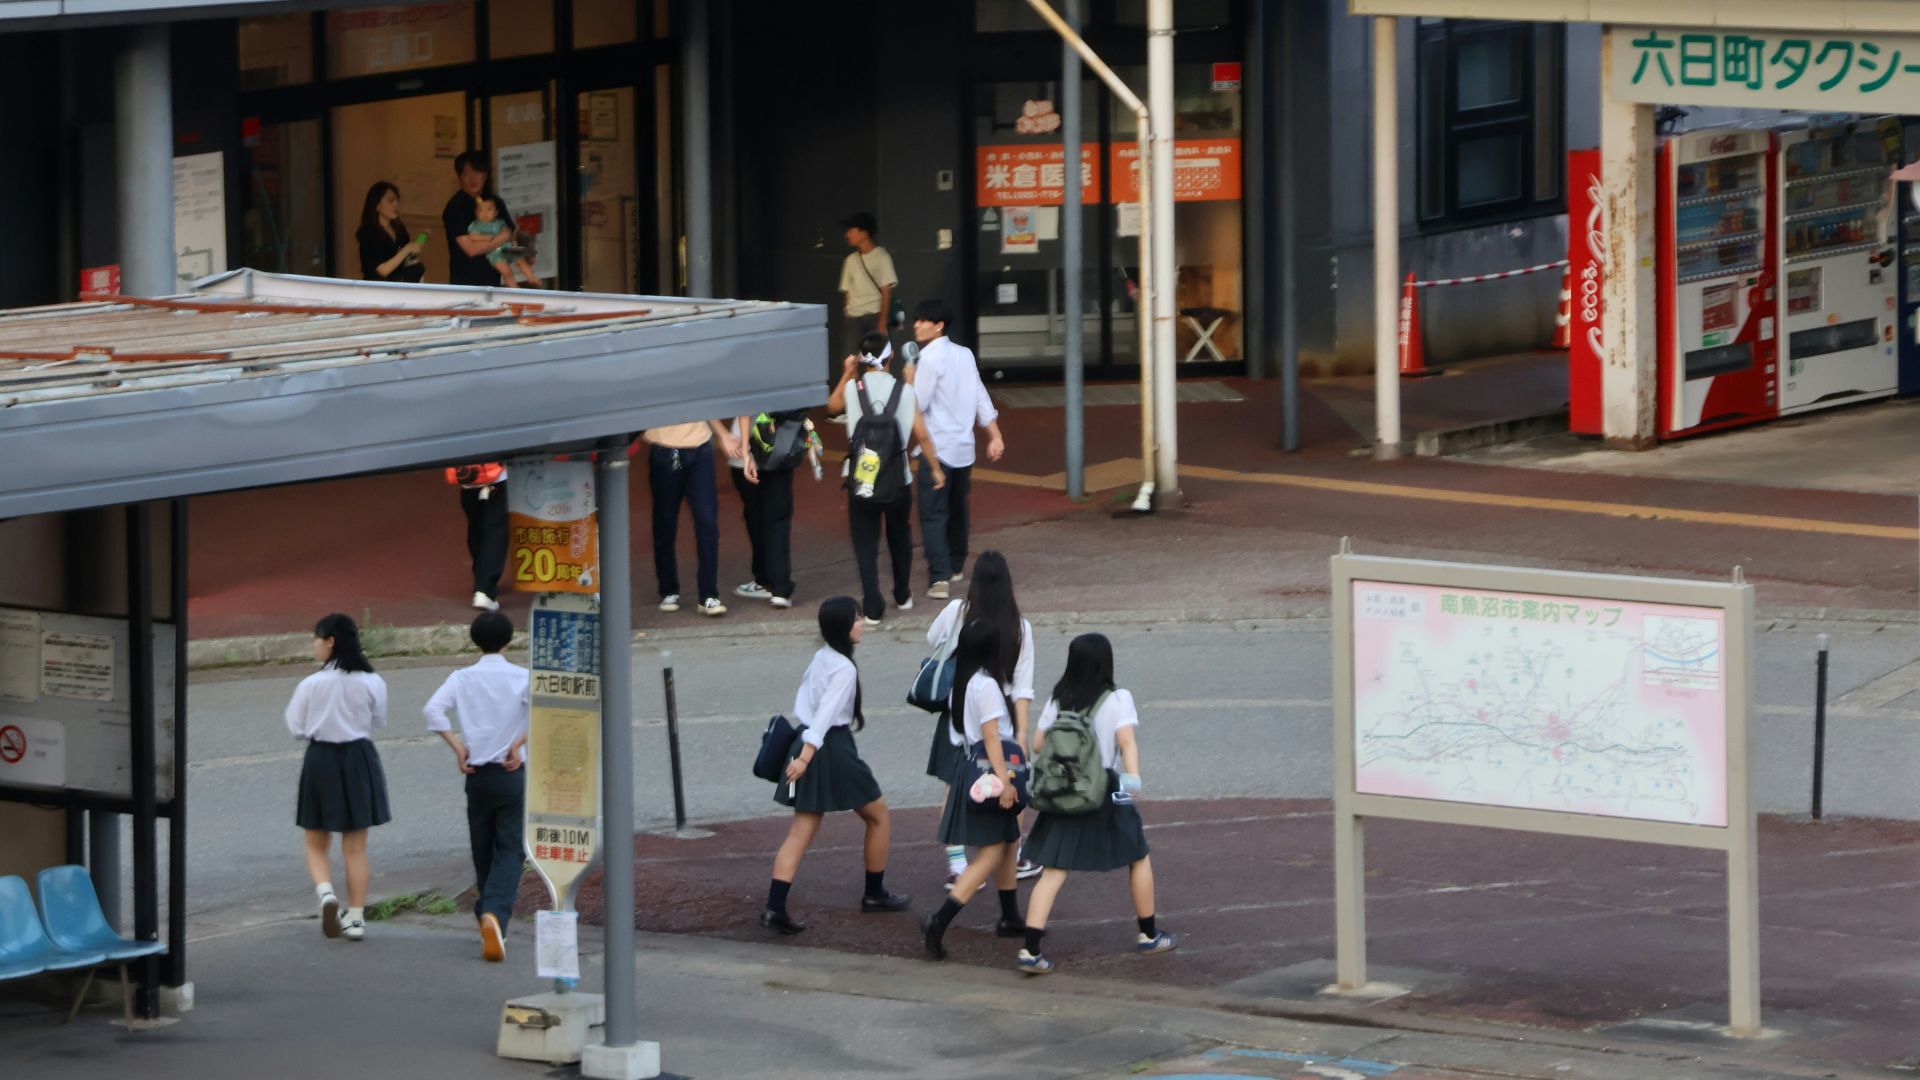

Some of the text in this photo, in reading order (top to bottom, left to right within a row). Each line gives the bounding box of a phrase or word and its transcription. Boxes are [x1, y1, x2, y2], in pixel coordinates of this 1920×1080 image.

[1440, 593, 1624, 628] 南魚沼市案内マップ
[535, 674, 598, 697] 六日町駅前
[535, 826, 590, 847] 前後10M
[535, 844, 589, 865] 駐車禁止
